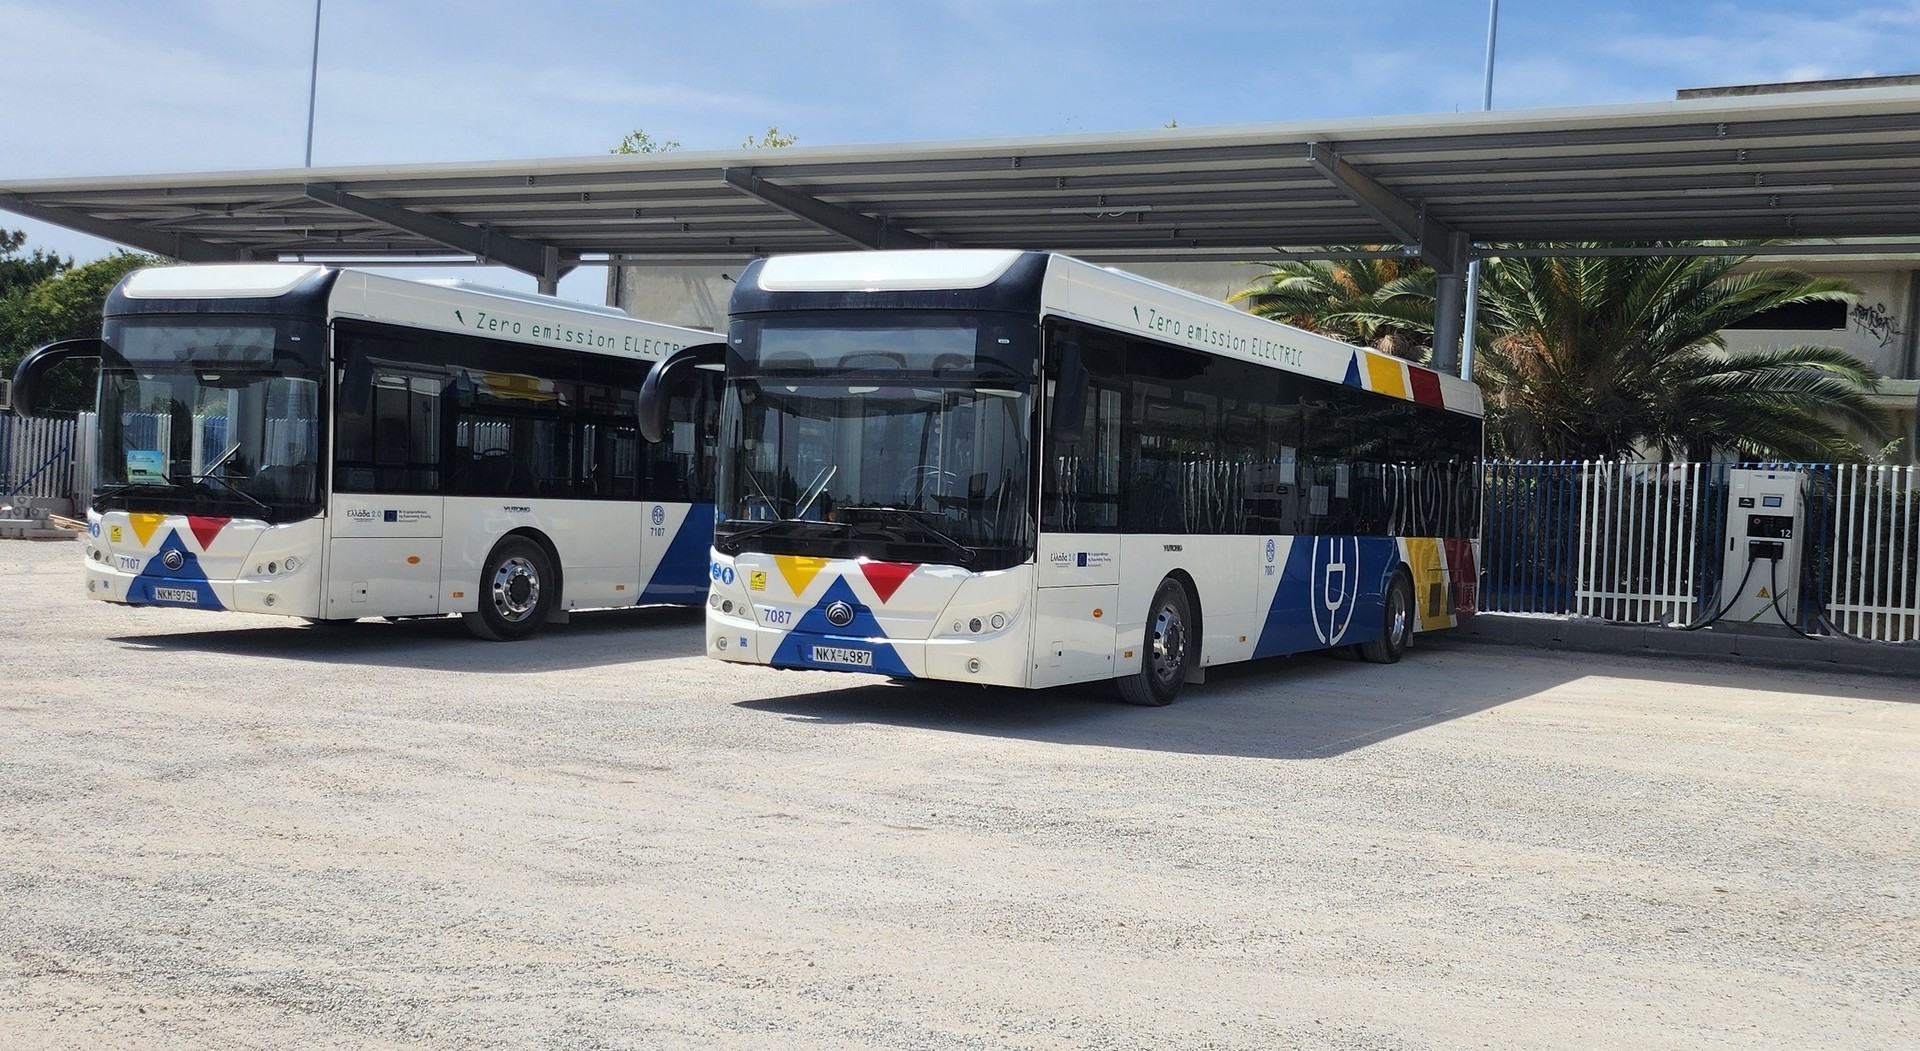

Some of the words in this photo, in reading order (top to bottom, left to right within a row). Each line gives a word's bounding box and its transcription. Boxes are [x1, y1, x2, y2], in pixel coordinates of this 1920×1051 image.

[476, 312, 521, 335] Zero
[532, 324, 615, 349] emission
[624, 336, 688, 356] ELECTR
[1148, 308, 1181, 335] Zero
[1187, 323, 1246, 353] emission
[1251, 337, 1303, 367] ELECTRIC
[650, 527, 665, 537] 7107
[1780, 529, 1791, 538] 12
[120, 557, 140, 570] 7107
[764, 608, 792, 625] 7087
[815, 647, 871, 665] NKX-4987
